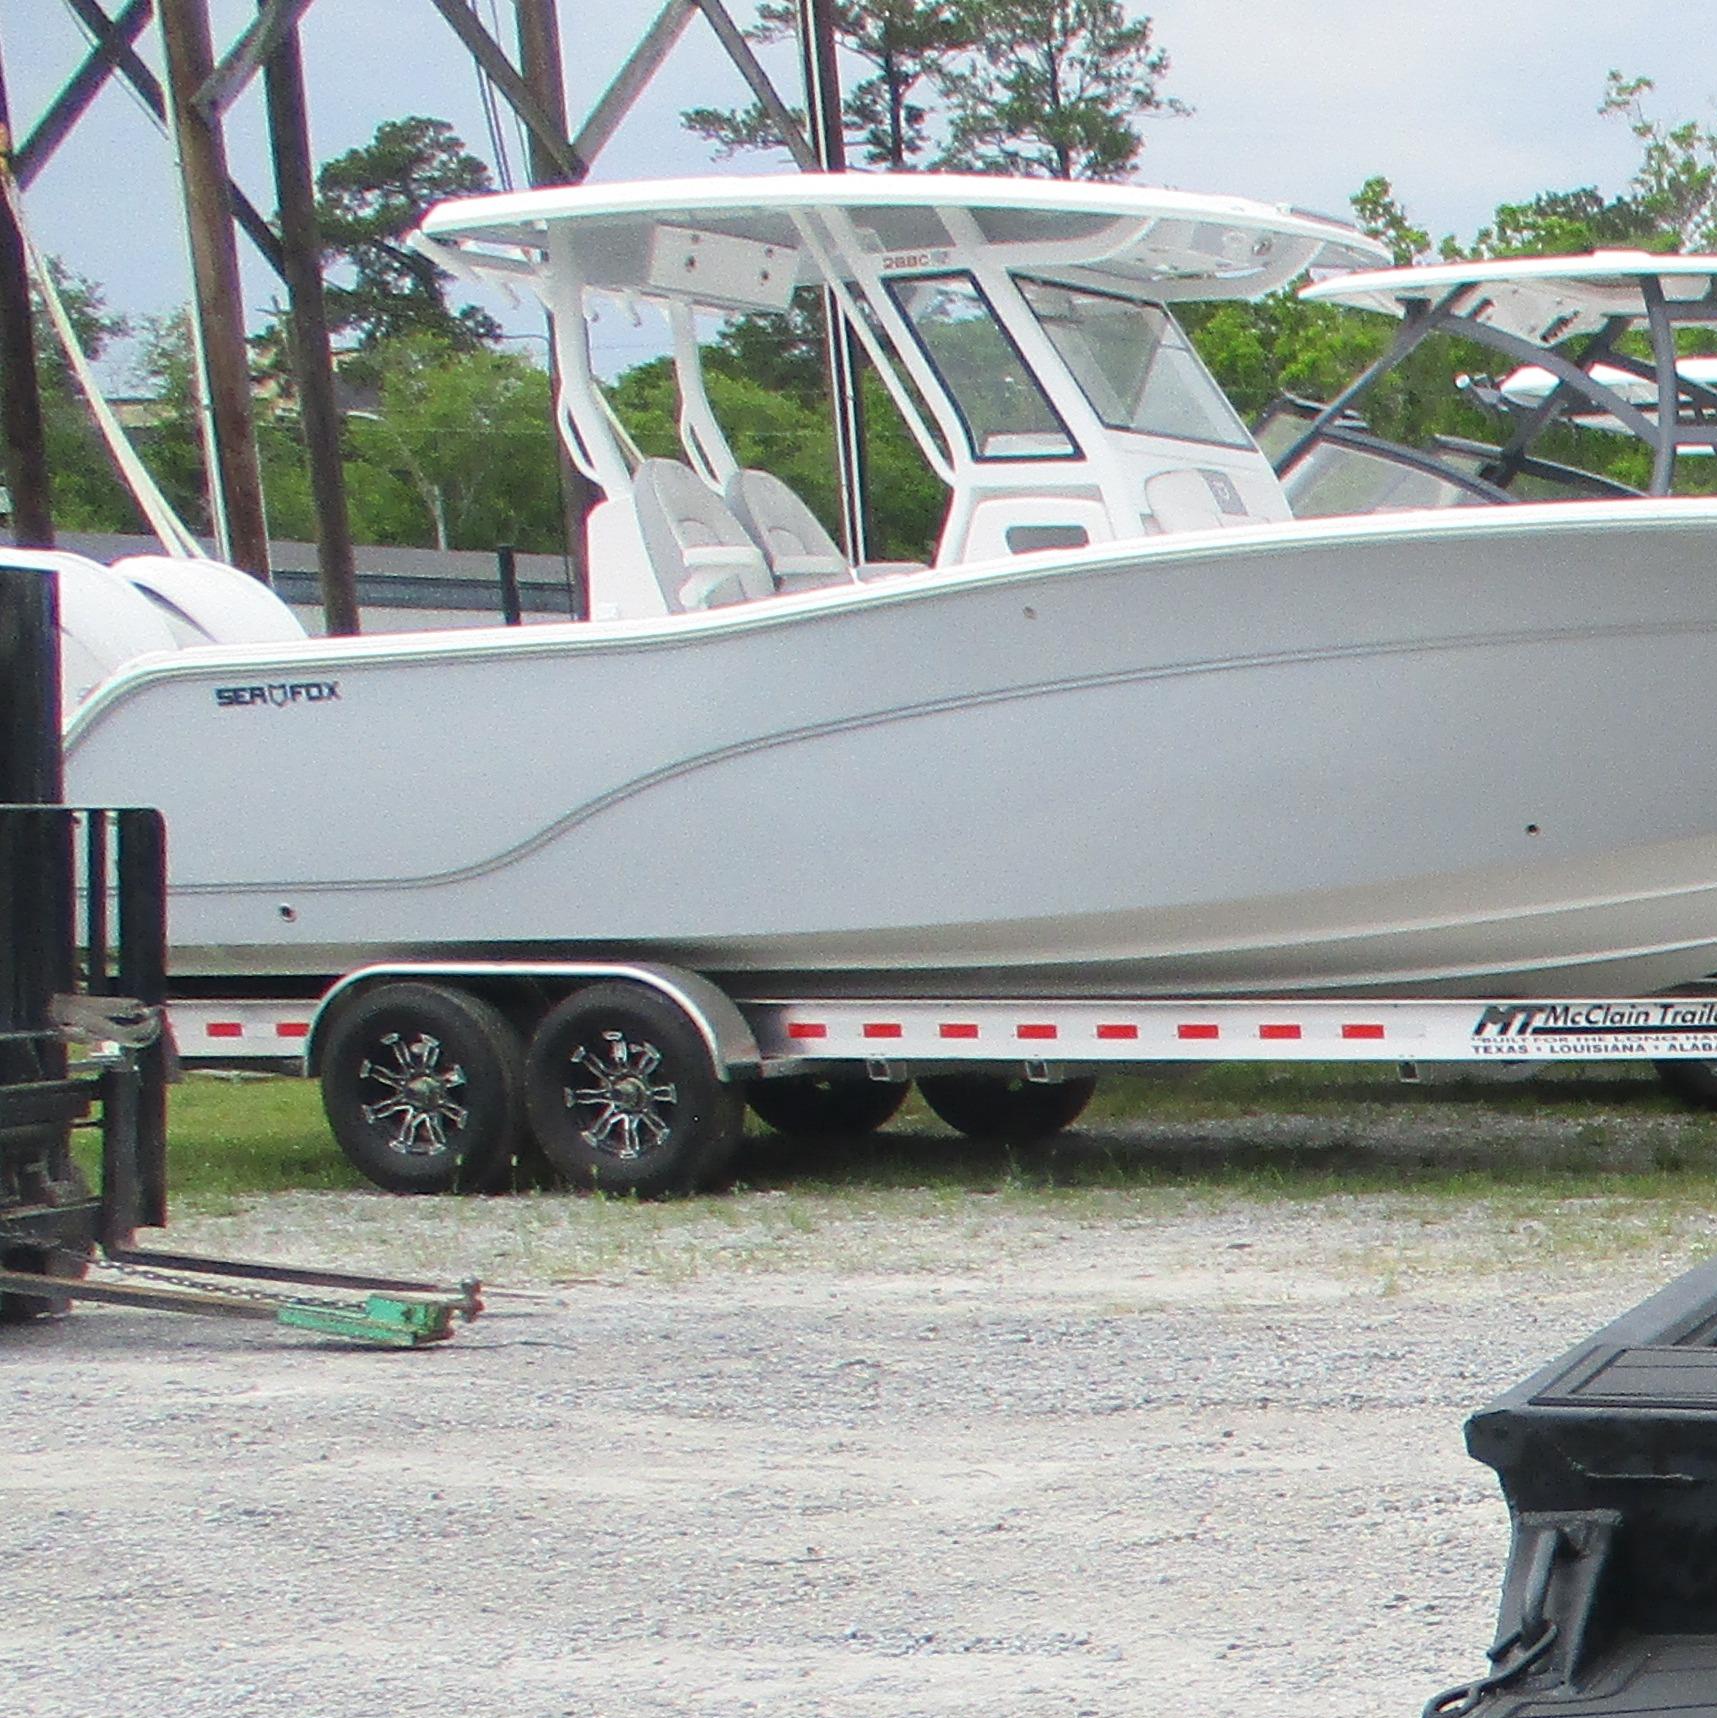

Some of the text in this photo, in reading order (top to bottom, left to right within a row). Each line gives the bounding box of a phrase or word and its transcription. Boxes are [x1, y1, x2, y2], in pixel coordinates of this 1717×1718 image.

[216, 681, 341, 706] SEA FOX
[1543, 1004, 1650, 1026] McClain
[1471, 1044, 1529, 1055] TEXAS
[1549, 1043, 1647, 1055] LOUISIANA
